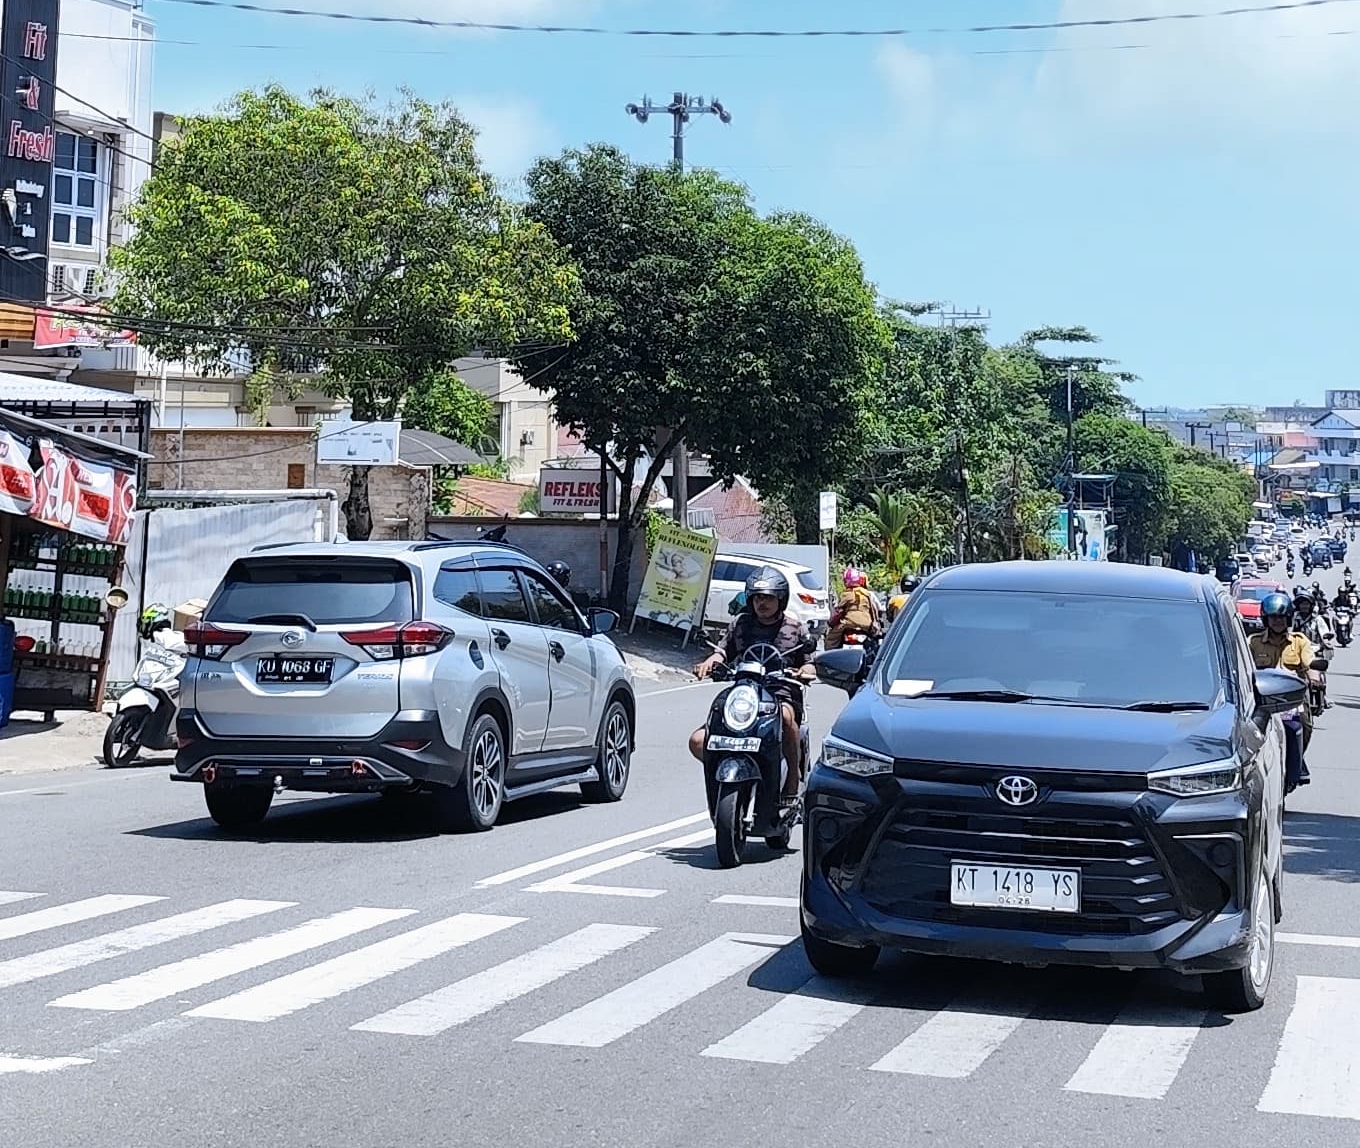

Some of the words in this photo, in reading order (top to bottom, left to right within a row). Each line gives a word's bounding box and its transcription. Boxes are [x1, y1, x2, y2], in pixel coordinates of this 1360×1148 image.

[24, 22, 48, 61] Fit
[8, 120, 53, 163] Fresh
[258, 659, 276, 673] KU
[315, 660, 332, 674] GF
[958, 868, 978, 891] KT
[993, 870, 1034, 893] 1418
[1052, 873, 1072, 896] YS
